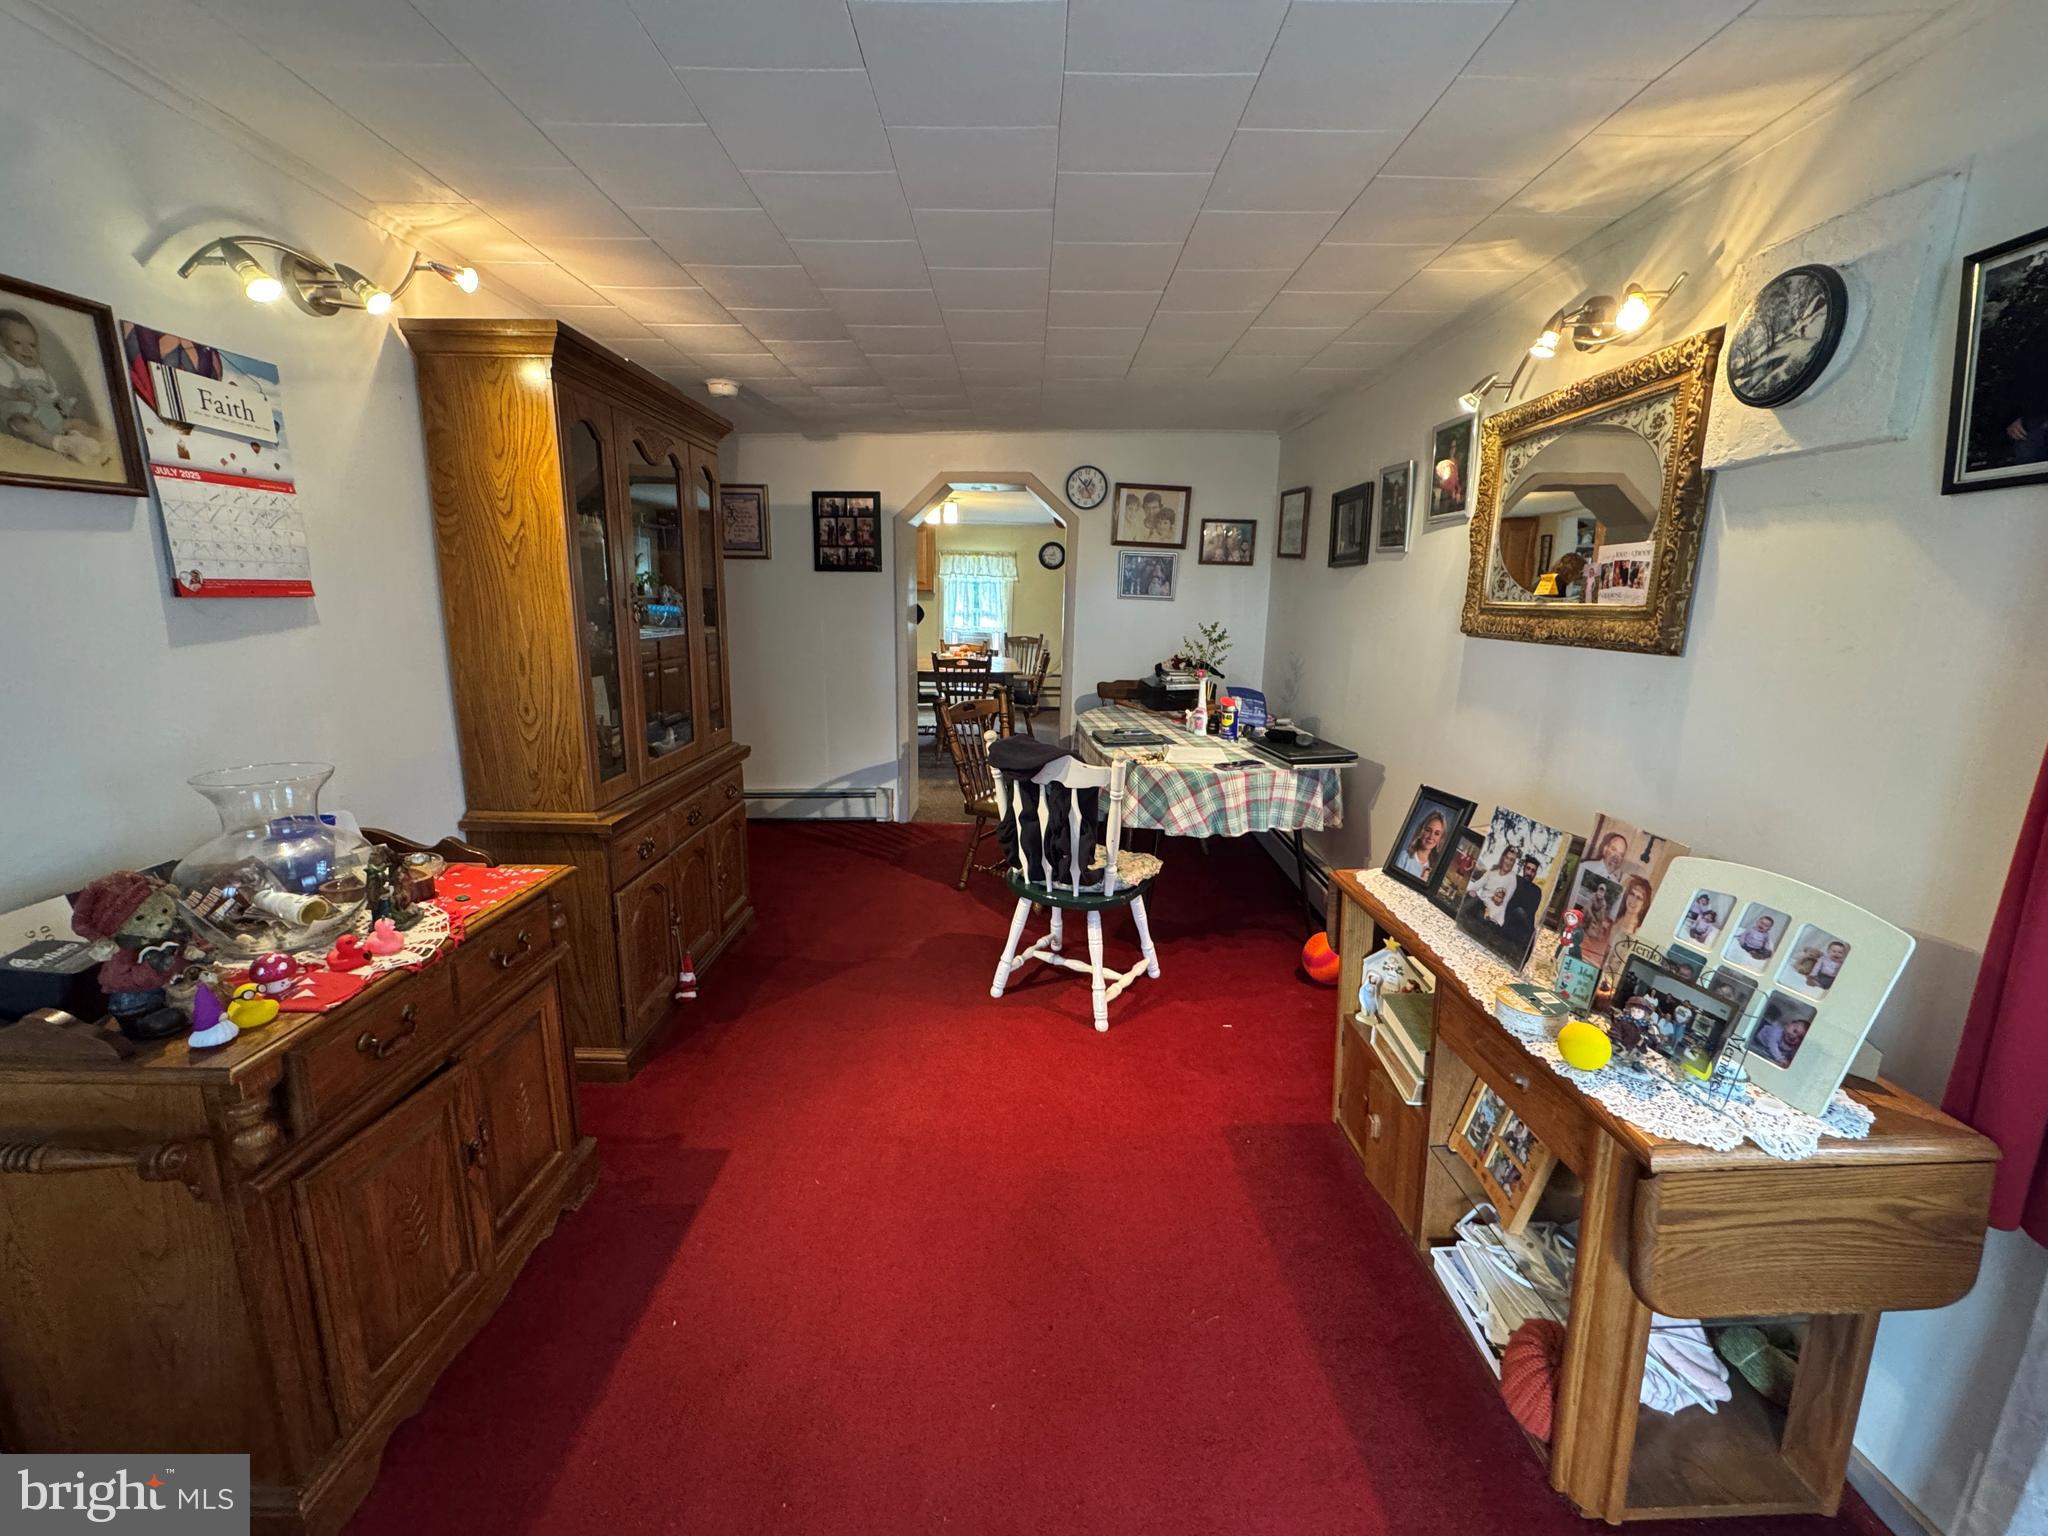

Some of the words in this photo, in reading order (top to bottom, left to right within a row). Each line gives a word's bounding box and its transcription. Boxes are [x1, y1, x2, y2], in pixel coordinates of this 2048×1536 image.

[197, 388, 256, 423] Faith
[154, 466, 178, 477] JULY
[179, 469, 201, 480] 2025
